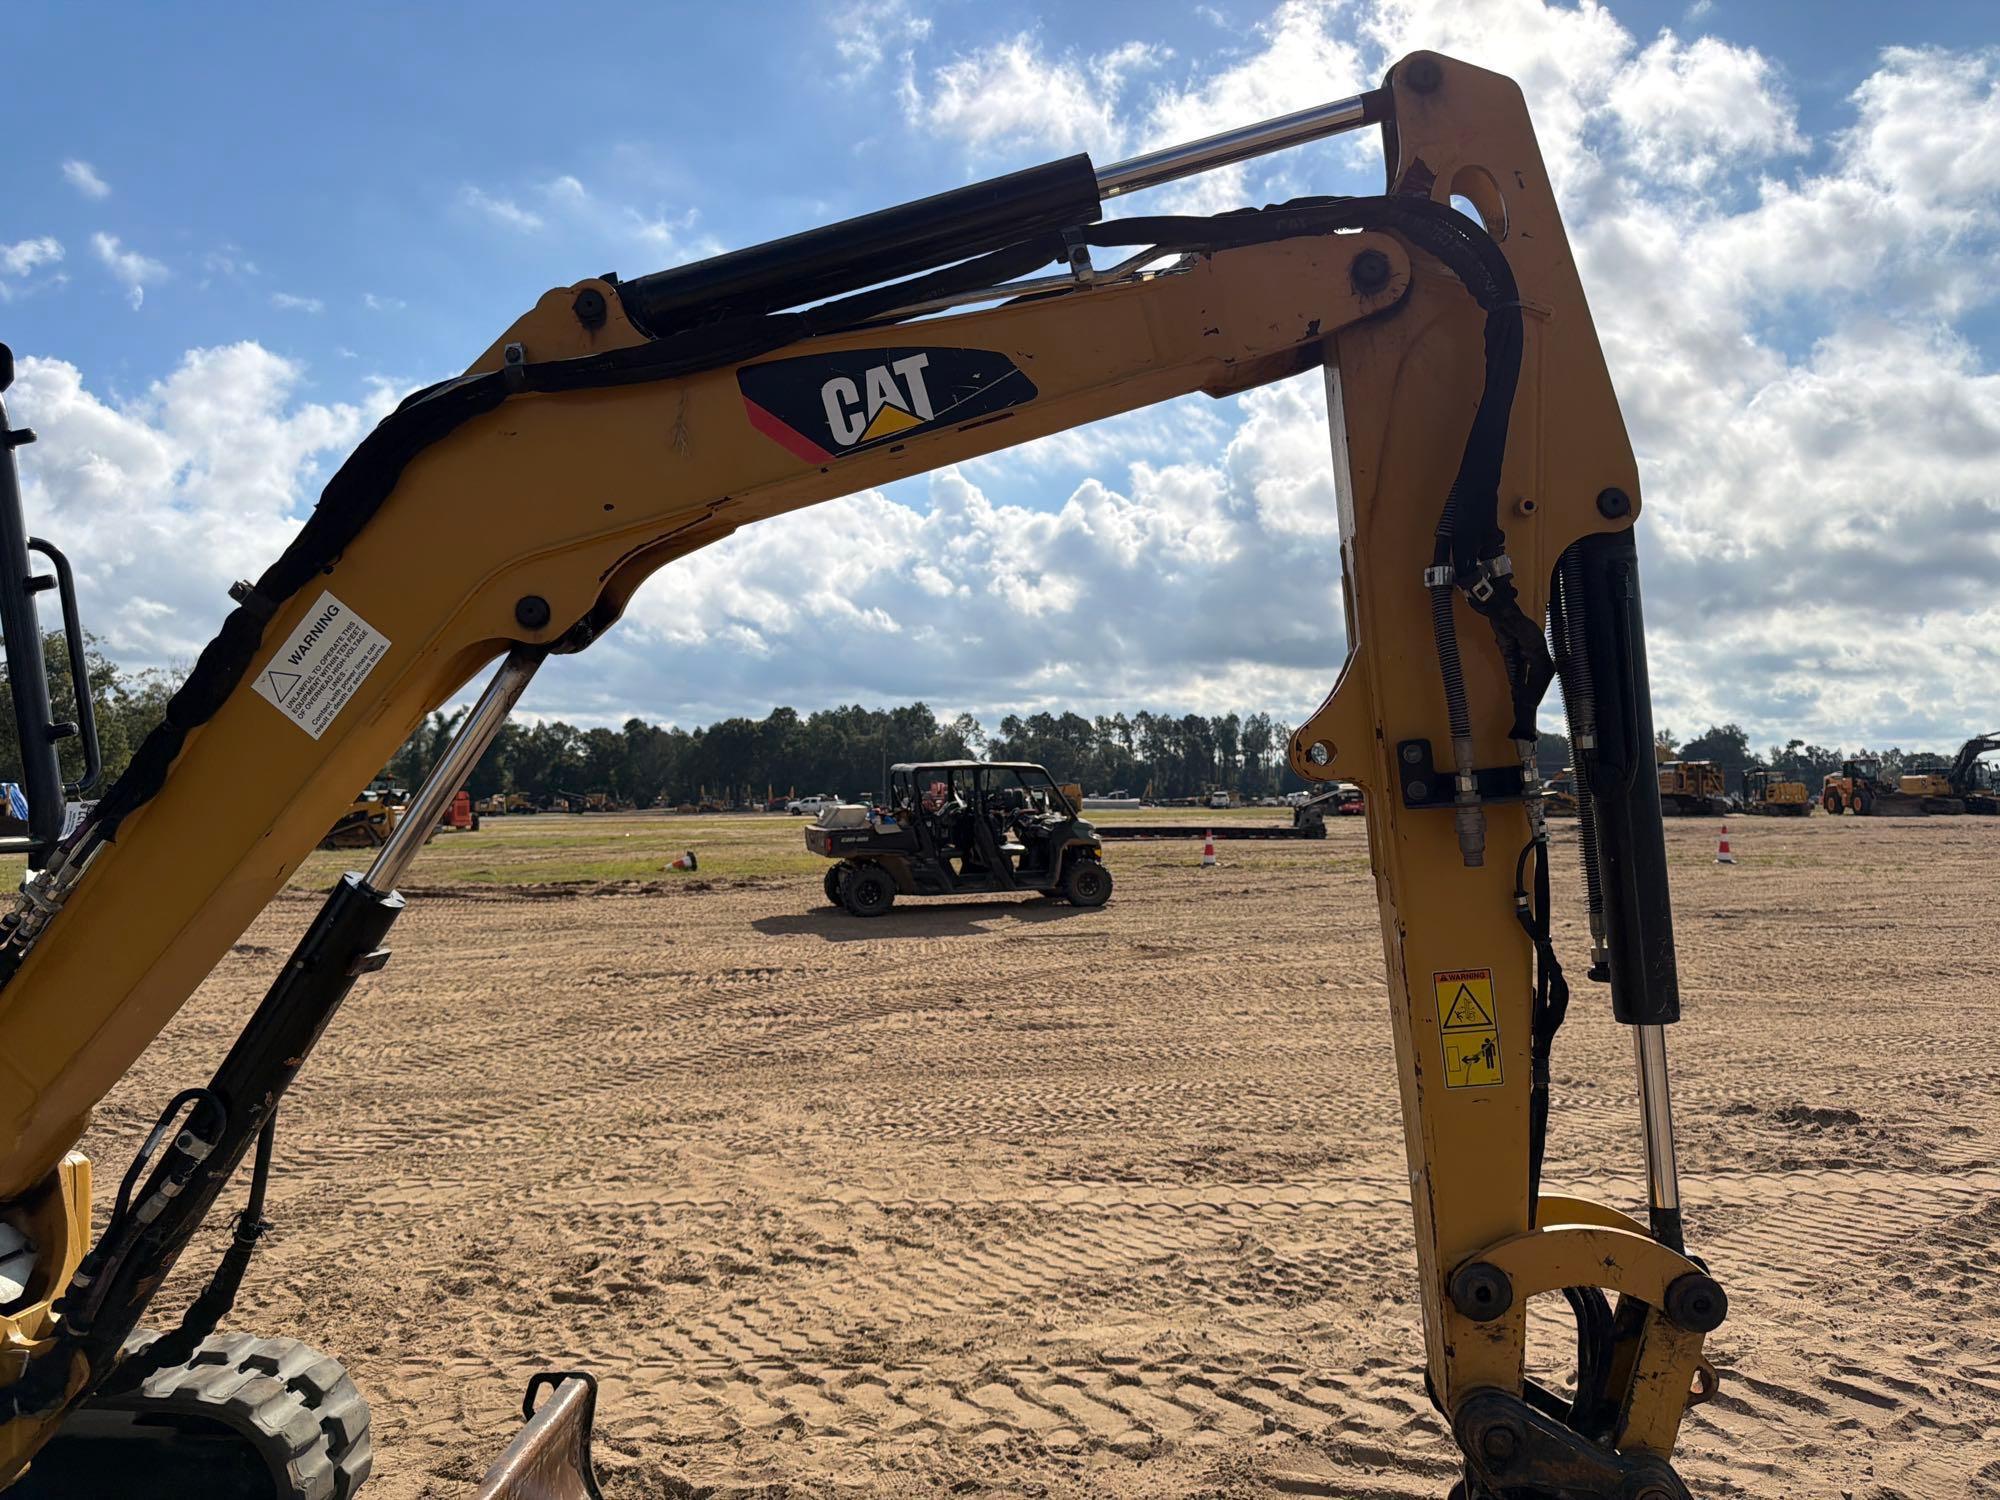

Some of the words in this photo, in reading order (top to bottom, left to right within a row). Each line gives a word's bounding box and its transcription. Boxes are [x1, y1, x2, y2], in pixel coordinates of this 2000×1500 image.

[821, 352, 935, 446] CAT
[286, 675, 316, 709] UNLAWFUL
[311, 664, 322, 675] TO
[319, 635, 345, 666] OPERATE
[341, 621, 356, 636] THIS
[287, 604, 340, 665] WARNING
[291, 676, 322, 714] EQUIPMENT
[319, 654, 340, 678] WITHIN
[336, 642, 349, 656] TEN
[346, 625, 361, 643] FEET
[297, 708, 306, 720] OF
[304, 674, 334, 710] OVERHEAD
[331, 629, 369, 676] HIGH-VOLTAGE
[311, 701, 333, 726] Contact
[330, 688, 343, 702] with
[340, 669, 357, 690] power
[354, 655, 369, 671] lines
[366, 642, 378, 656] can
[314, 716, 330, 735] result
[326, 709, 335, 717] in
[333, 692, 349, 710] death
[344, 684, 354, 693] or
[352, 662, 372, 686] serious
[369, 645, 387, 663] burns.
[328, 671, 346, 691] LINES
[1448, 972, 1485, 981] WARNING
